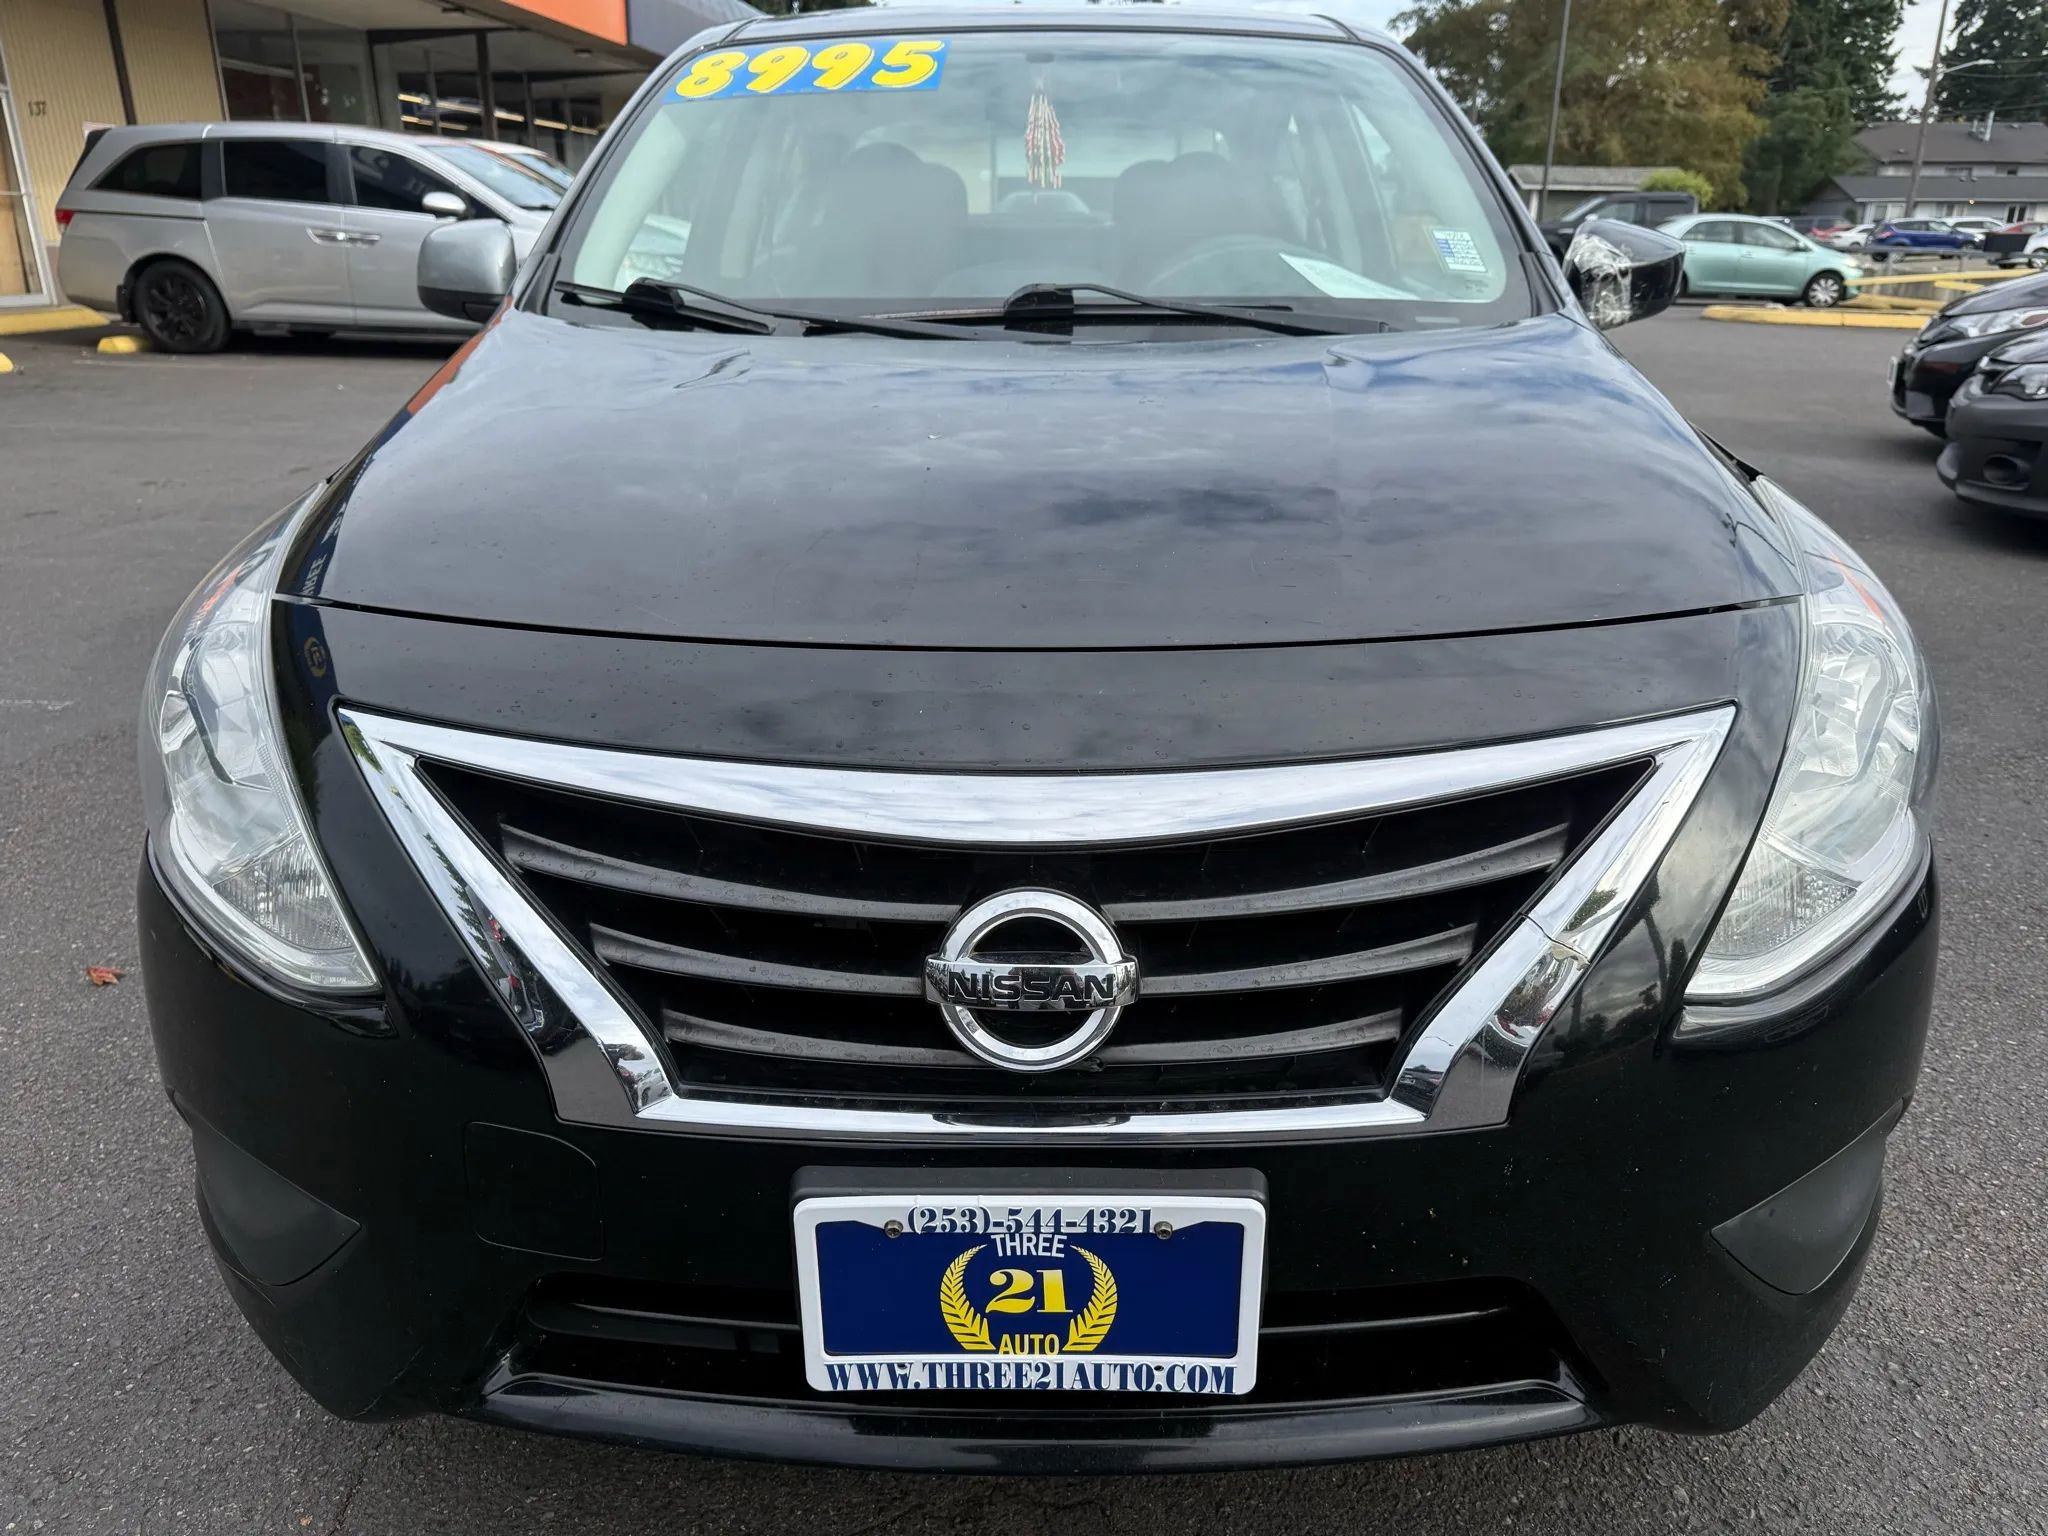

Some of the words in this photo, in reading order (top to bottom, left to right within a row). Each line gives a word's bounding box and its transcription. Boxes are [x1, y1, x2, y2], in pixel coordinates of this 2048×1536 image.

[675, 40, 945, 98] 8995
[948, 970, 1115, 1001] NISSAN
[907, 1207, 1153, 1235] (253)-544-4321
[991, 1233, 1067, 1258] THREE
[985, 1268, 1073, 1314] 21
[999, 1334, 1059, 1356] AUTO
[824, 1361, 1238, 1395] WWW.THREE21AUTO.COM
